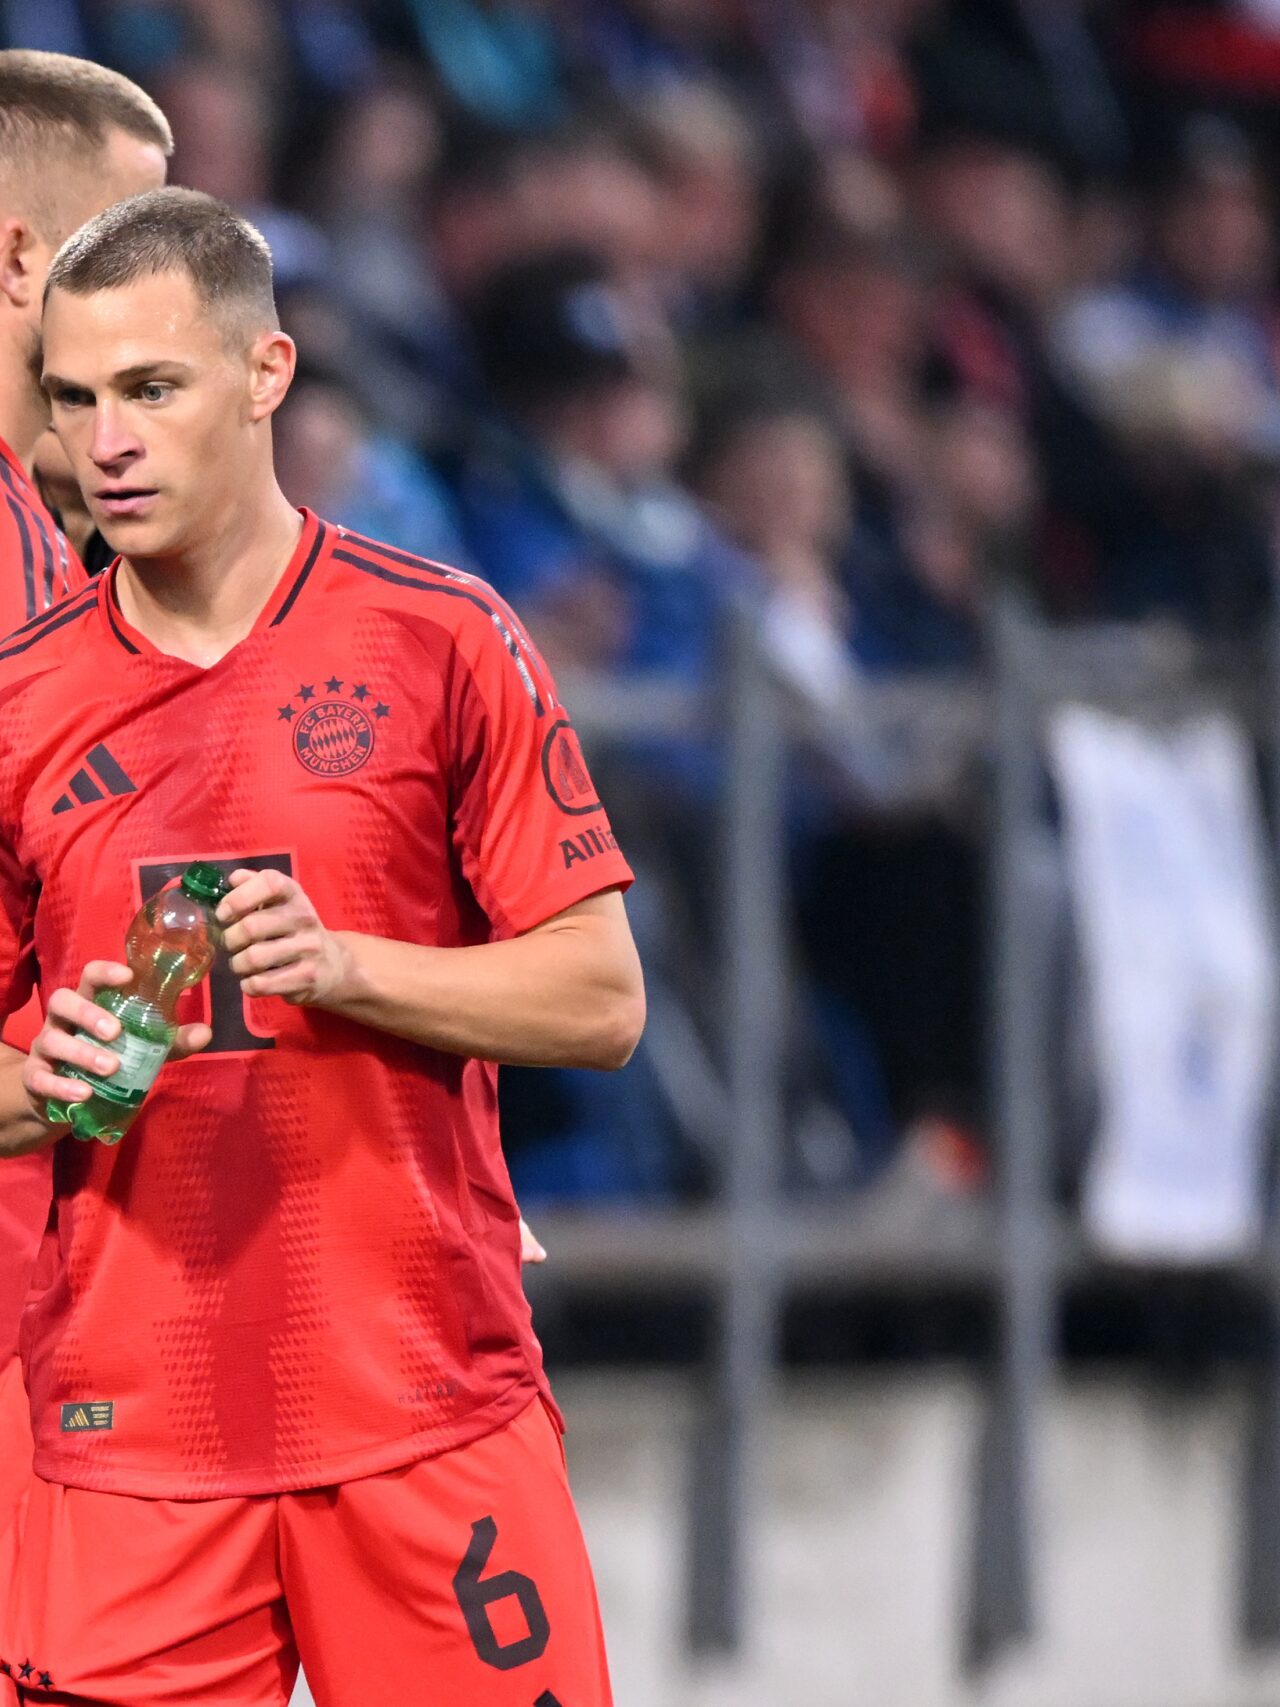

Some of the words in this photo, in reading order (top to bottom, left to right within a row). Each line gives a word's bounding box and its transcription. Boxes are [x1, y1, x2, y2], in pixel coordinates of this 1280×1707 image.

[300, 716, 316, 734] FC
[315, 705, 368, 733] BAYERN
[451, 1514, 552, 1672] 6
